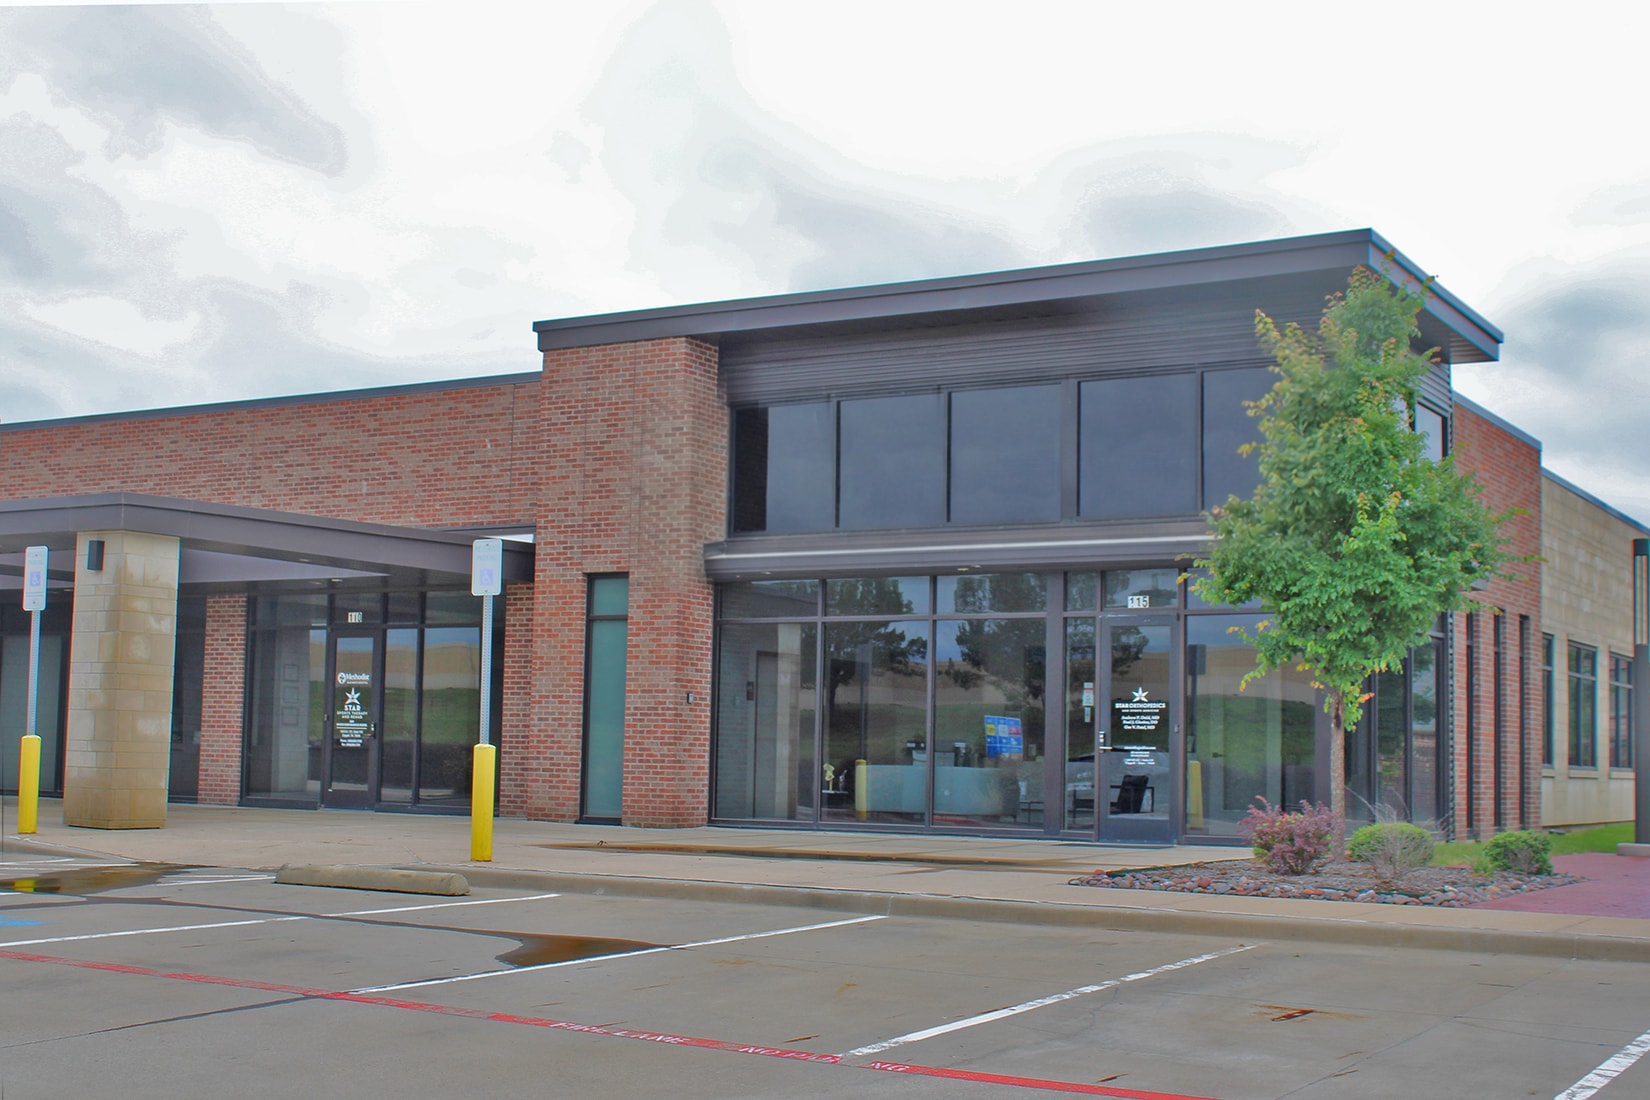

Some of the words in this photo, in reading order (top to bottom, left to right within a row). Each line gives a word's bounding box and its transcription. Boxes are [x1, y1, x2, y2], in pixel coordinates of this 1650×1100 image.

[1129, 596, 1149, 608] 115
[346, 672, 370, 681] Methodist
[549, 1022, 608, 1034] FIRE
[611, 1030, 690, 1044] LANE
[739, 1047, 781, 1056] NO
